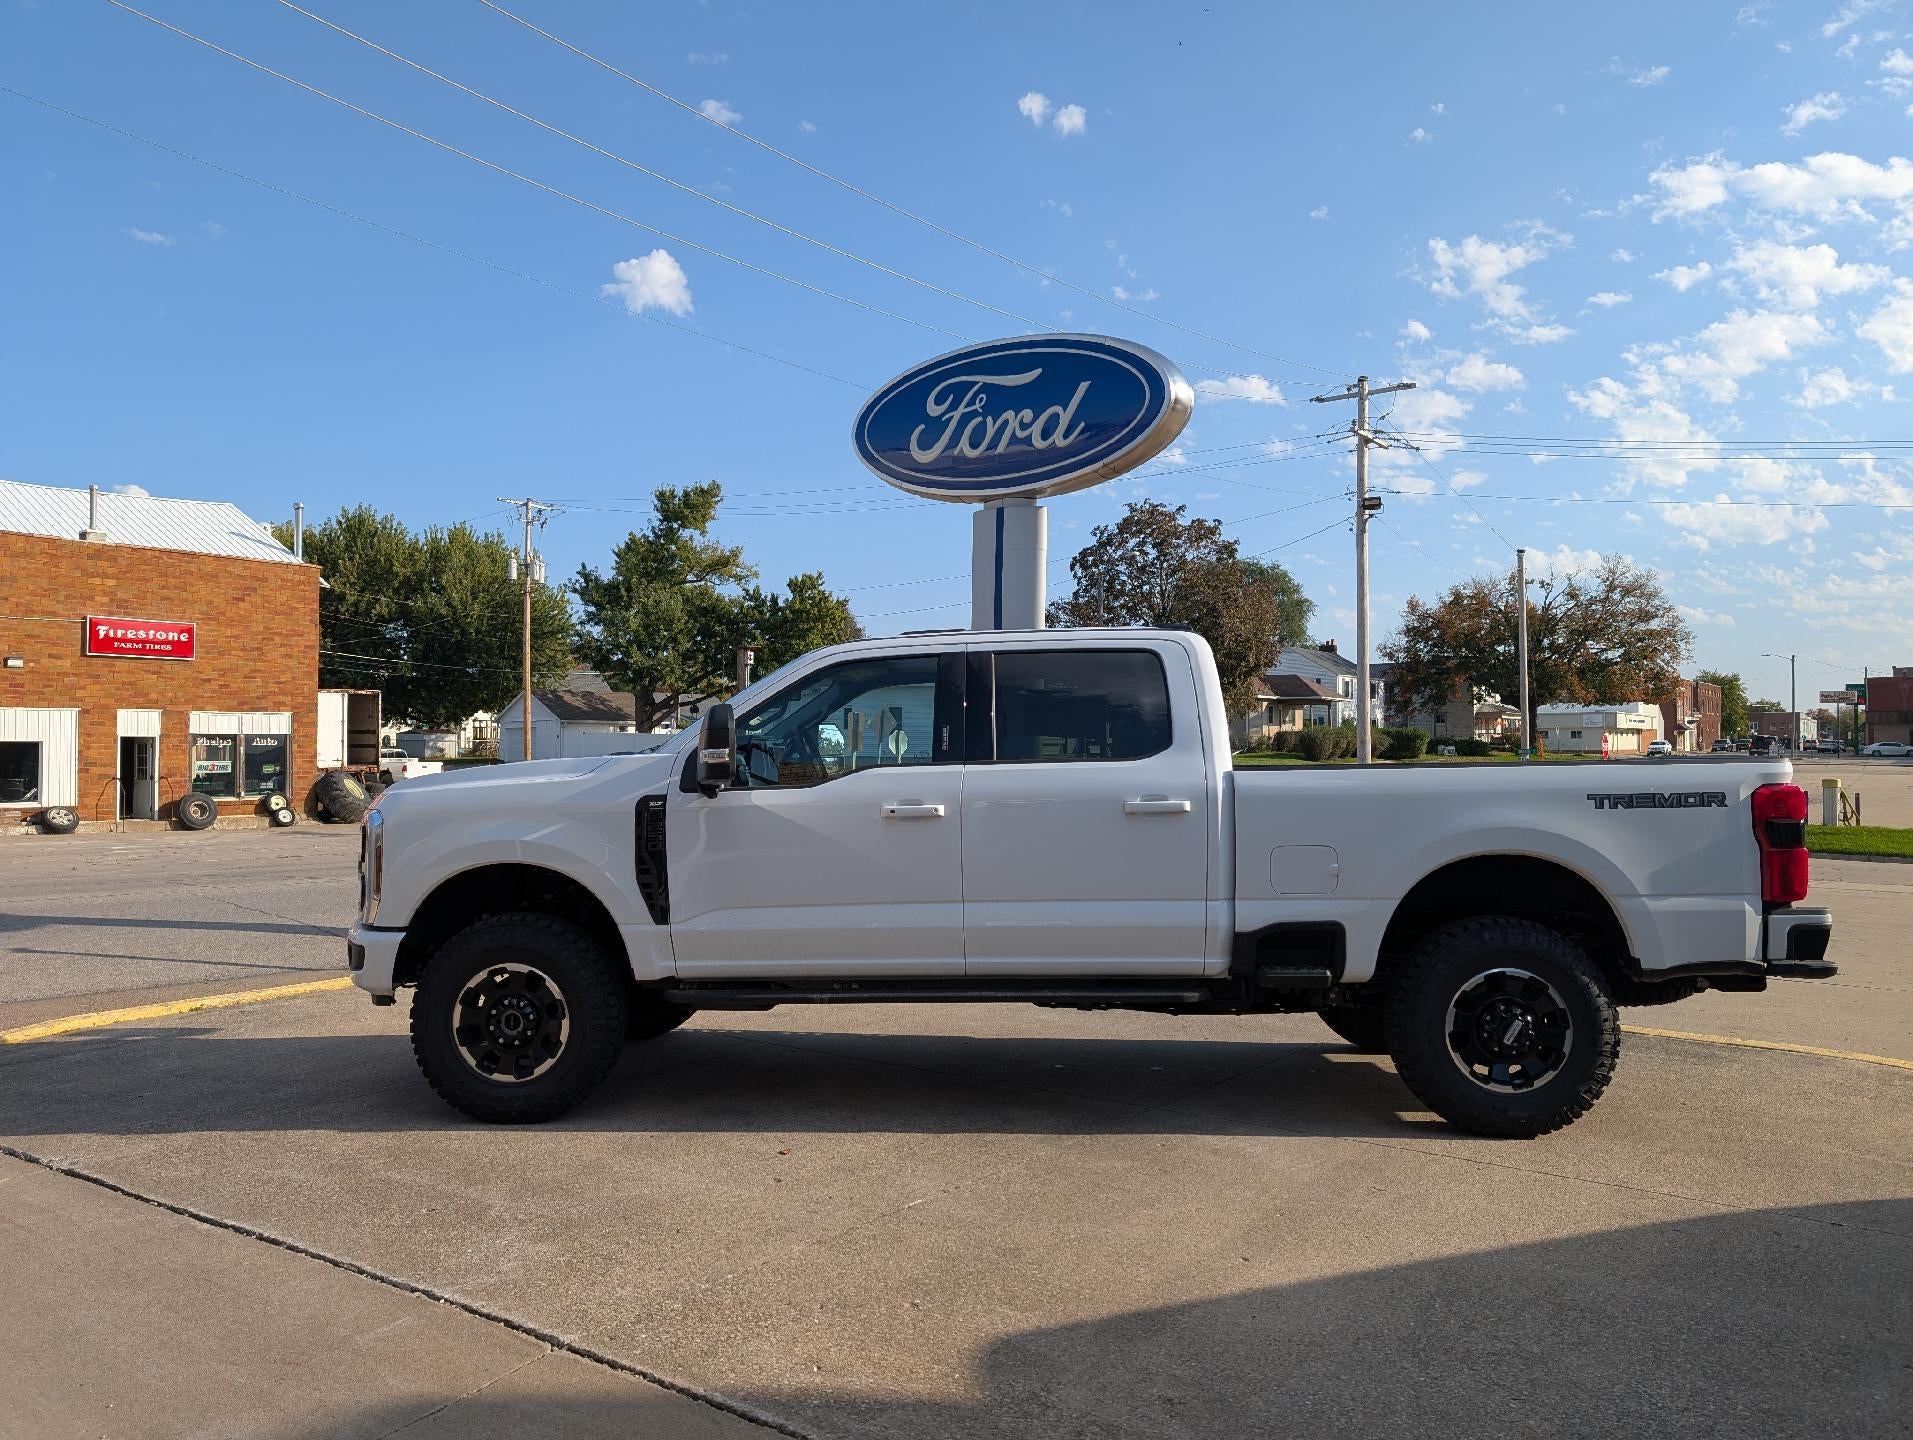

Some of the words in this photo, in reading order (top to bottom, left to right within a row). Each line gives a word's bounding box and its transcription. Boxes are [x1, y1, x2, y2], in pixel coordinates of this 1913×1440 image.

[909, 367, 1092, 464] Ford
[96, 625, 189, 642] Firestone
[113, 641, 143, 649] FARM
[145, 643, 172, 651] TIRES
[196, 736, 232, 748] Phelps
[252, 737, 278, 746] Auto
[1586, 791, 1729, 810] TREMOR
